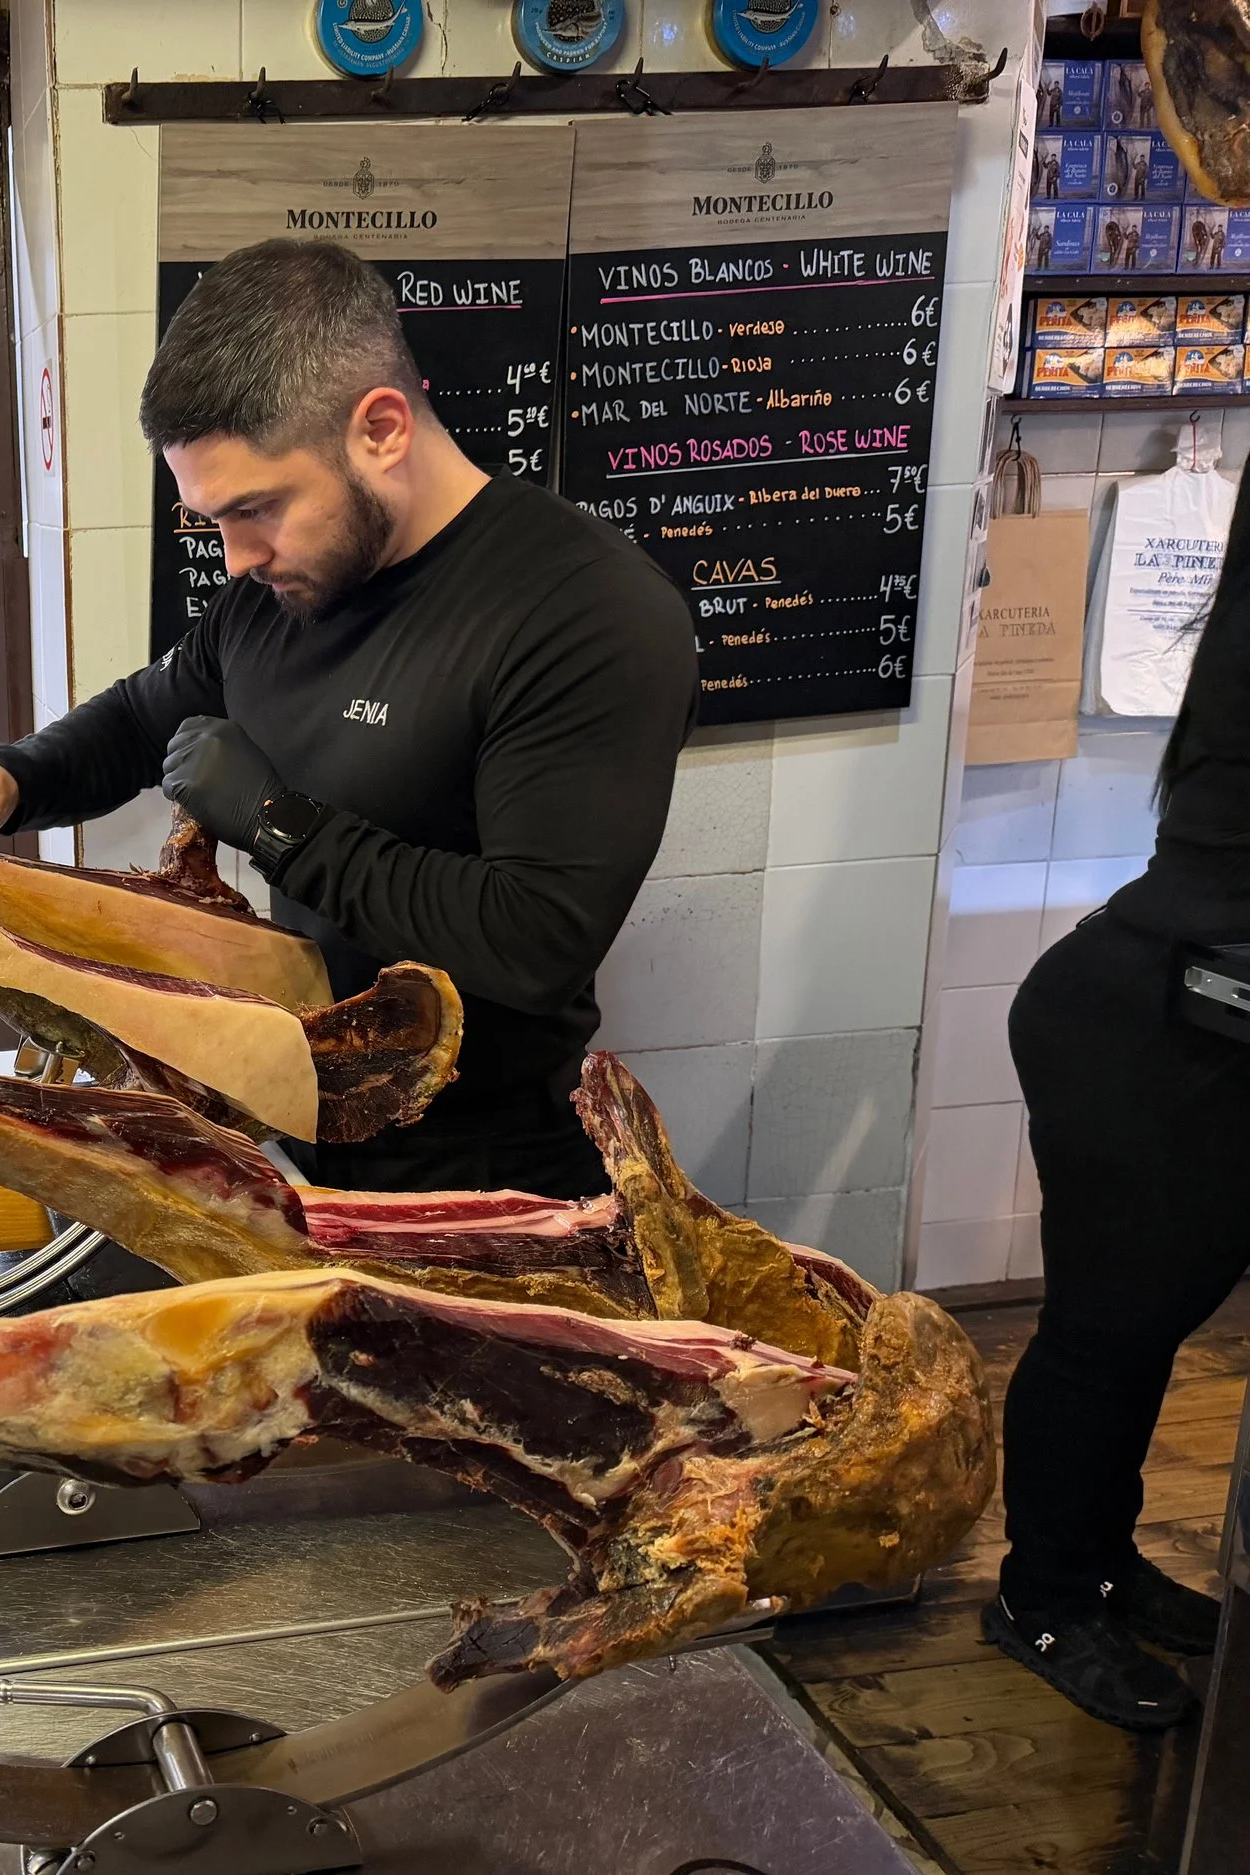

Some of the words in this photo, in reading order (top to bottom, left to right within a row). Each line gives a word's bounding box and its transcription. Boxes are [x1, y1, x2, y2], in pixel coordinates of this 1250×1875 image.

[361, 53, 384, 61] COMPANY
[691, 190, 834, 216] MONTECILLO
[286, 208, 438, 230] MONTECILLO
[598, 262, 678, 291] VINOS
[688, 257, 774, 284] BLANCOS
[800, 248, 866, 278] WHITE
[875, 248, 934, 277] WINE
[397, 271, 444, 306] RED
[452, 279, 523, 305] WINE
[581, 318, 713, 349] MONTECILLO
[582, 356, 720, 389] MONTECILLO
[581, 399, 630, 427] MAR
[639, 399, 669, 420] DEL
[684, 390, 753, 417] NORTE
[766, 388, 833, 410] Albariño
[607, 442, 682, 471] VINOS
[686, 434, 774, 464] ROSADOS
[798, 429, 849, 455] ROSE
[854, 424, 911, 449] WINE
[670, 494, 736, 517] ANGUIX
[801, 486, 820, 500] del
[824, 486, 862, 499] Duero
[660, 520, 714, 539] Penedés
[178, 535, 225, 560] PAG
[178, 566, 232, 588] PAG
[692, 556, 778, 586] CAVAS
[698, 596, 748, 618] BRUT
[765, 589, 815, 610] Penedés
[721, 627, 772, 647] Penedés
[999, 620, 1056, 638] PINEDA
[700, 673, 749, 692] Penedés
[342, 698, 391, 727] JENIA
